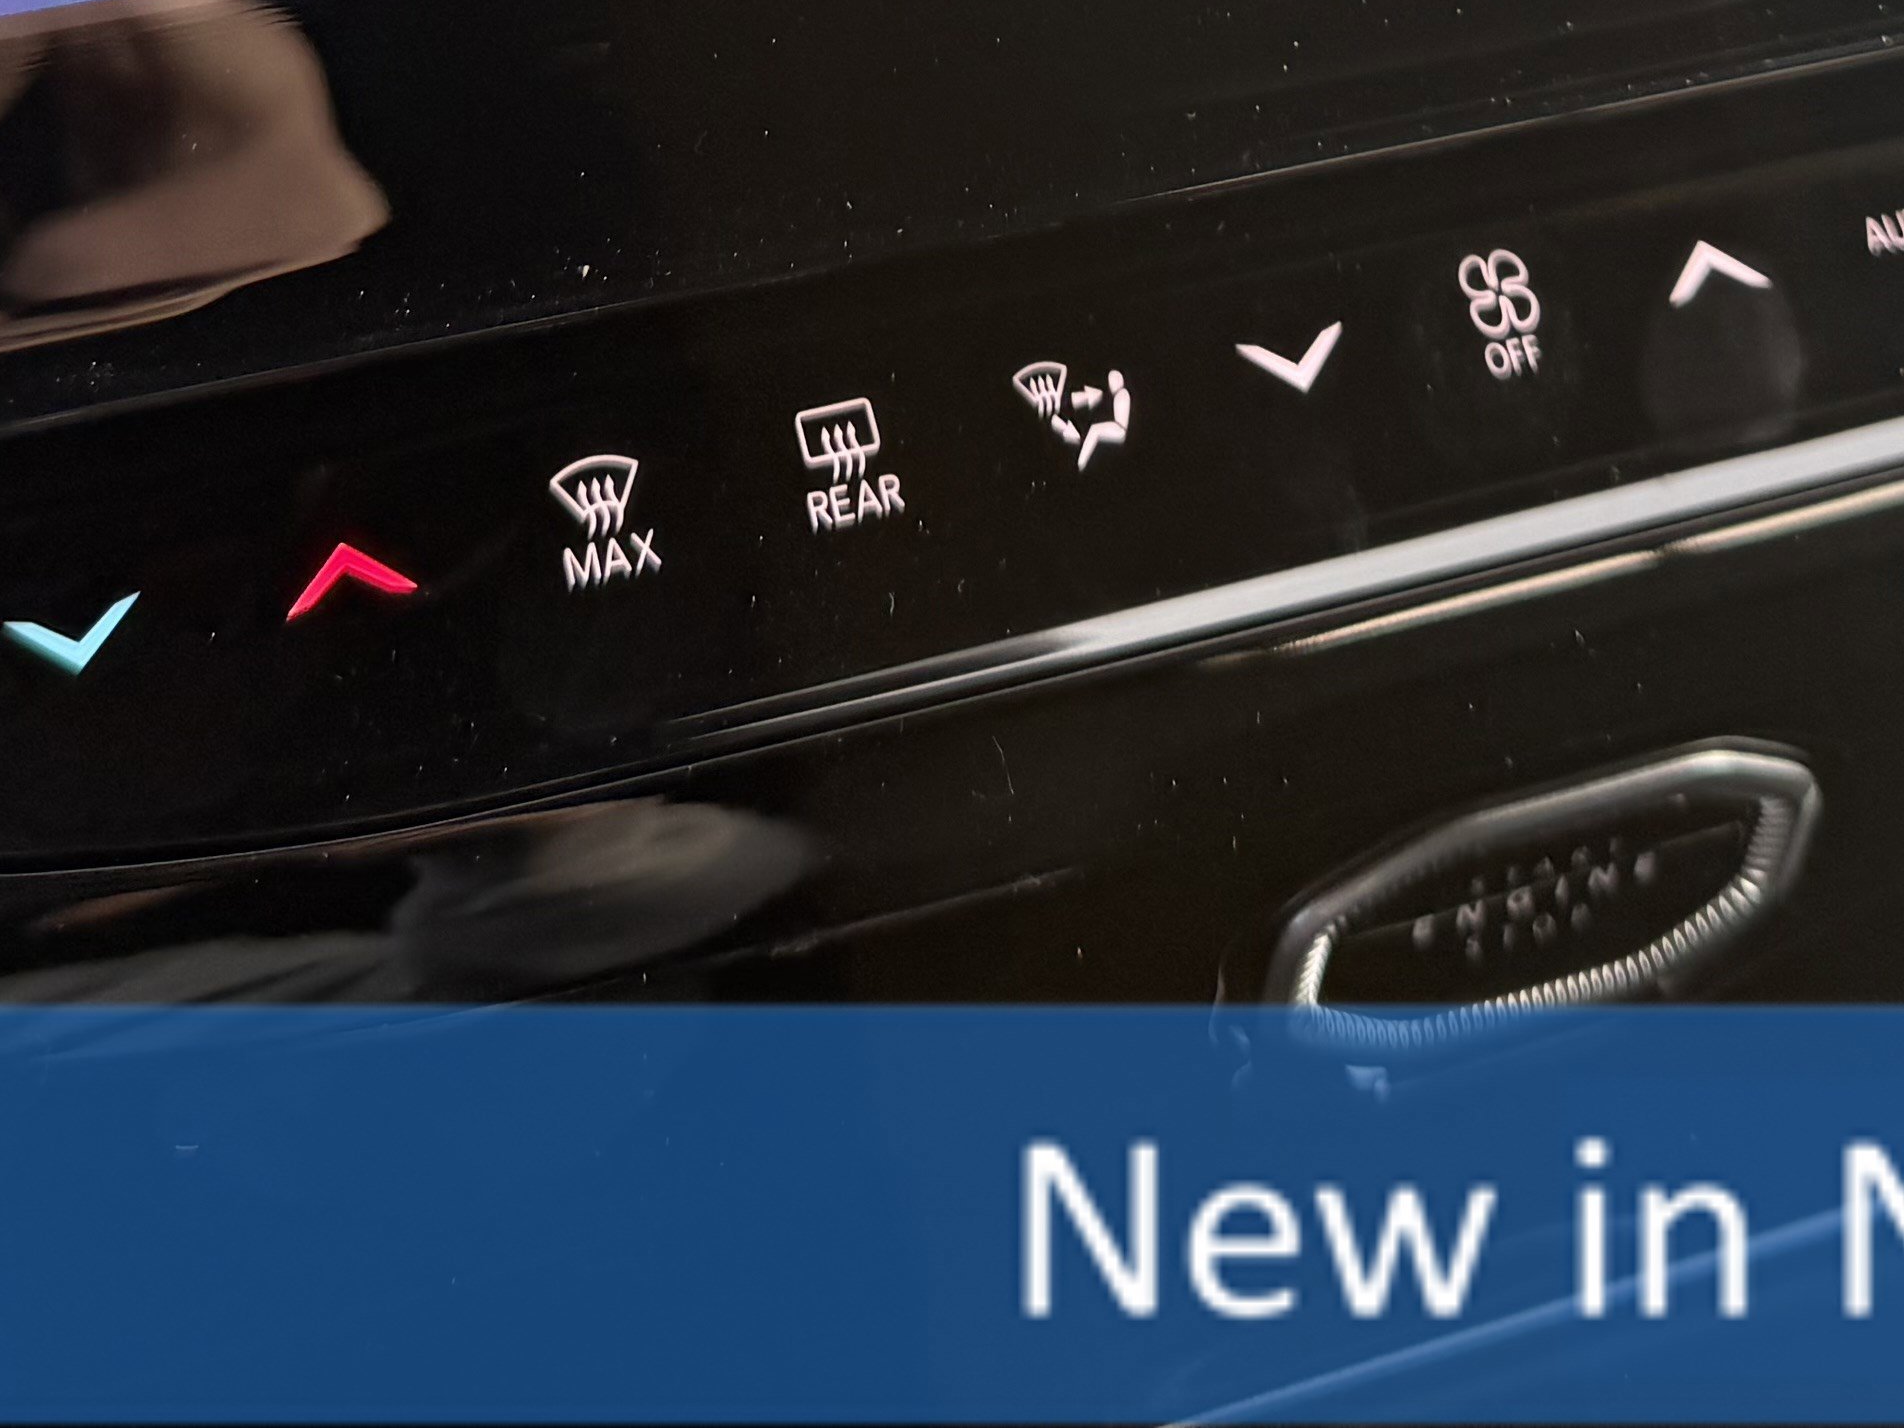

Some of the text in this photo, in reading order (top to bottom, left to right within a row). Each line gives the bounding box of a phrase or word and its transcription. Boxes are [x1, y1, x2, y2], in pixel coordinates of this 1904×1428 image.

[1485, 334, 1542, 379] OFF
[806, 471, 906, 533] REAR
[562, 526, 663, 591] MAX
